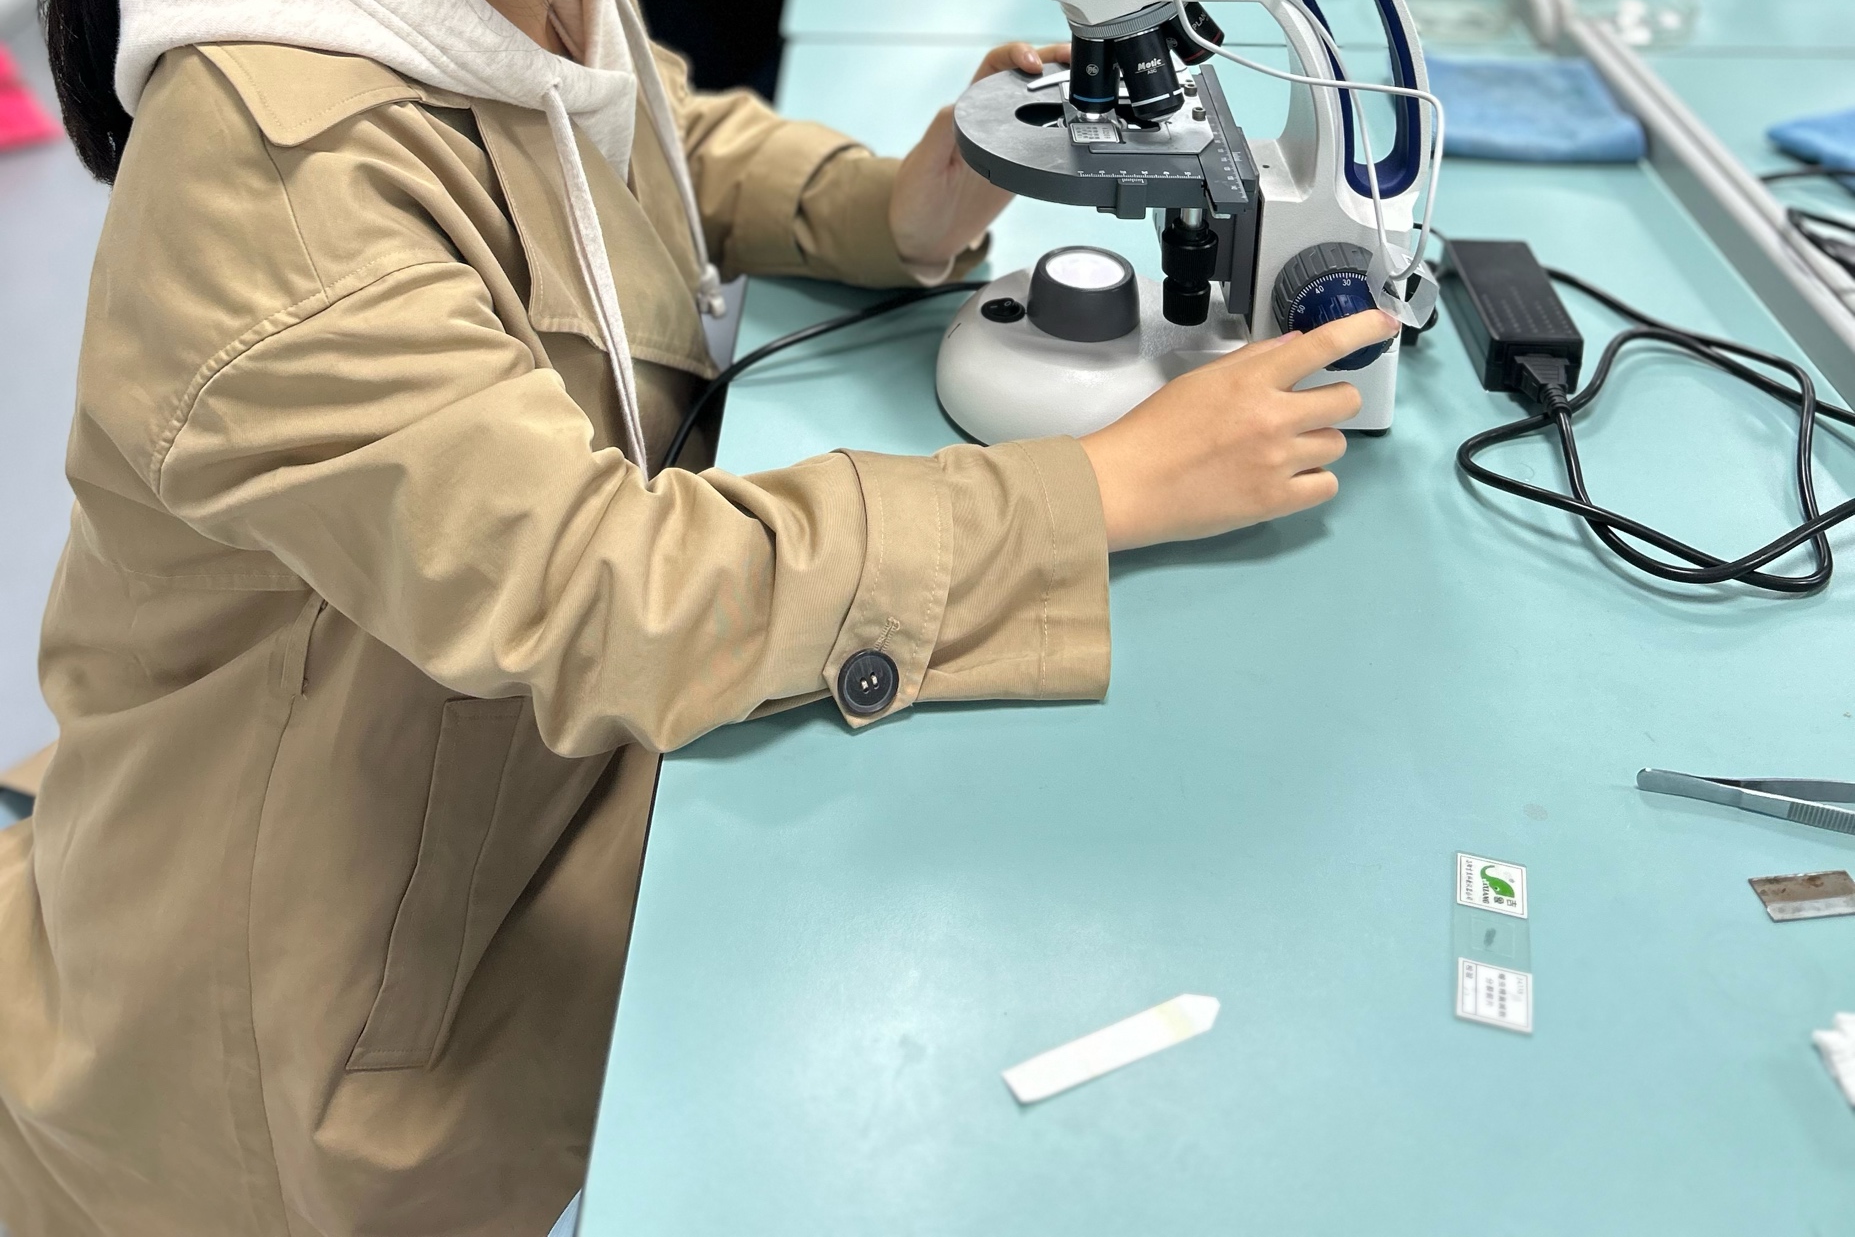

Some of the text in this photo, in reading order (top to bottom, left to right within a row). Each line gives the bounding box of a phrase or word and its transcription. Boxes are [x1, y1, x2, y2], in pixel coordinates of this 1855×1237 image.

[1137, 58, 1161, 71] Motic
[1315, 285, 1325, 294] 40
[1296, 304, 1306, 314] 50
